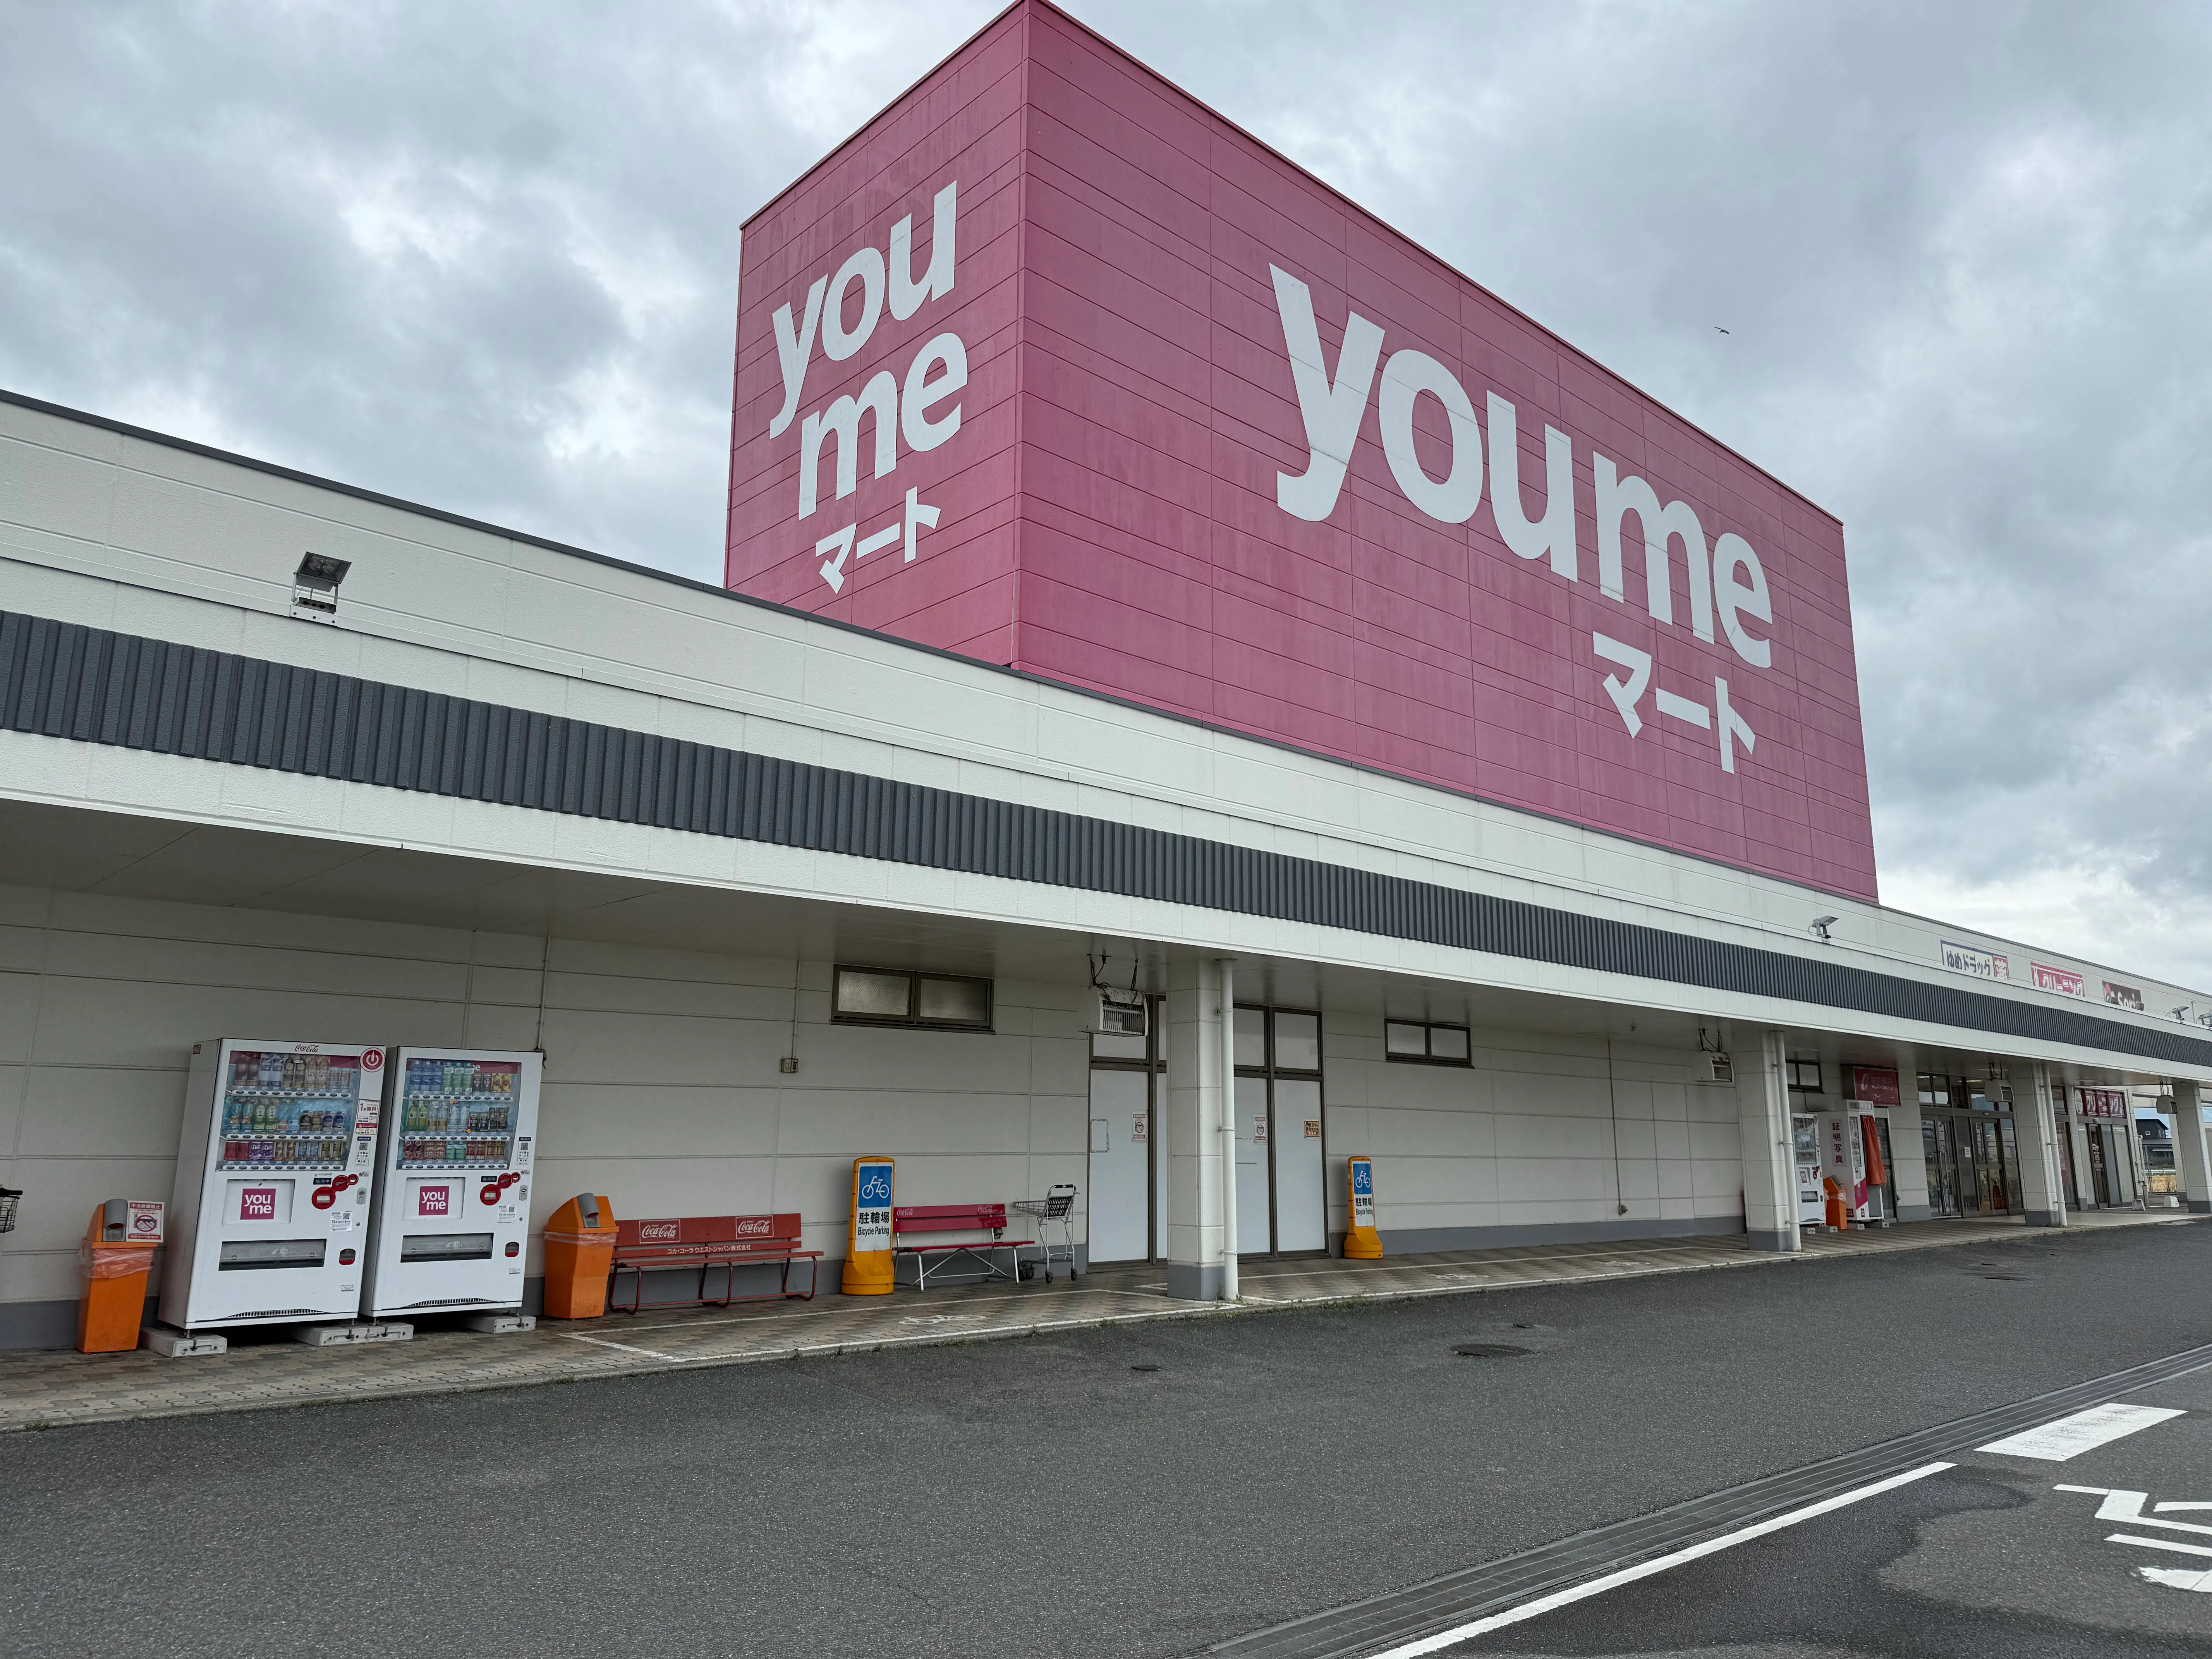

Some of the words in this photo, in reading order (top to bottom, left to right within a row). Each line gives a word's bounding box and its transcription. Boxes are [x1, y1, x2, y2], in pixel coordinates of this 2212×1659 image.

[769, 180, 957, 439] you
[799, 332, 968, 520] me
[816, 486, 941, 594] マート
[1592, 630, 1755, 775] マート
[2042, 973, 2084, 997] クリーニング
[2117, 991, 2138, 1009] Seri
[1832, 1123, 1843, 1163] 証明写真
[245, 1194, 271, 1207] you
[422, 1191, 445, 1203] you
[1355, 1197, 1372, 1207] 駐輪場
[249, 1204, 272, 1215] me
[426, 1201, 446, 1210] me
[859, 1211, 890, 1224] 駐輪場
[642, 1224, 678, 1238] Coca-Cola
[738, 1220, 771, 1234] Coca-Cola
[858, 1226, 874, 1237] Bicycle
[875, 1226, 889, 1236] Parking
